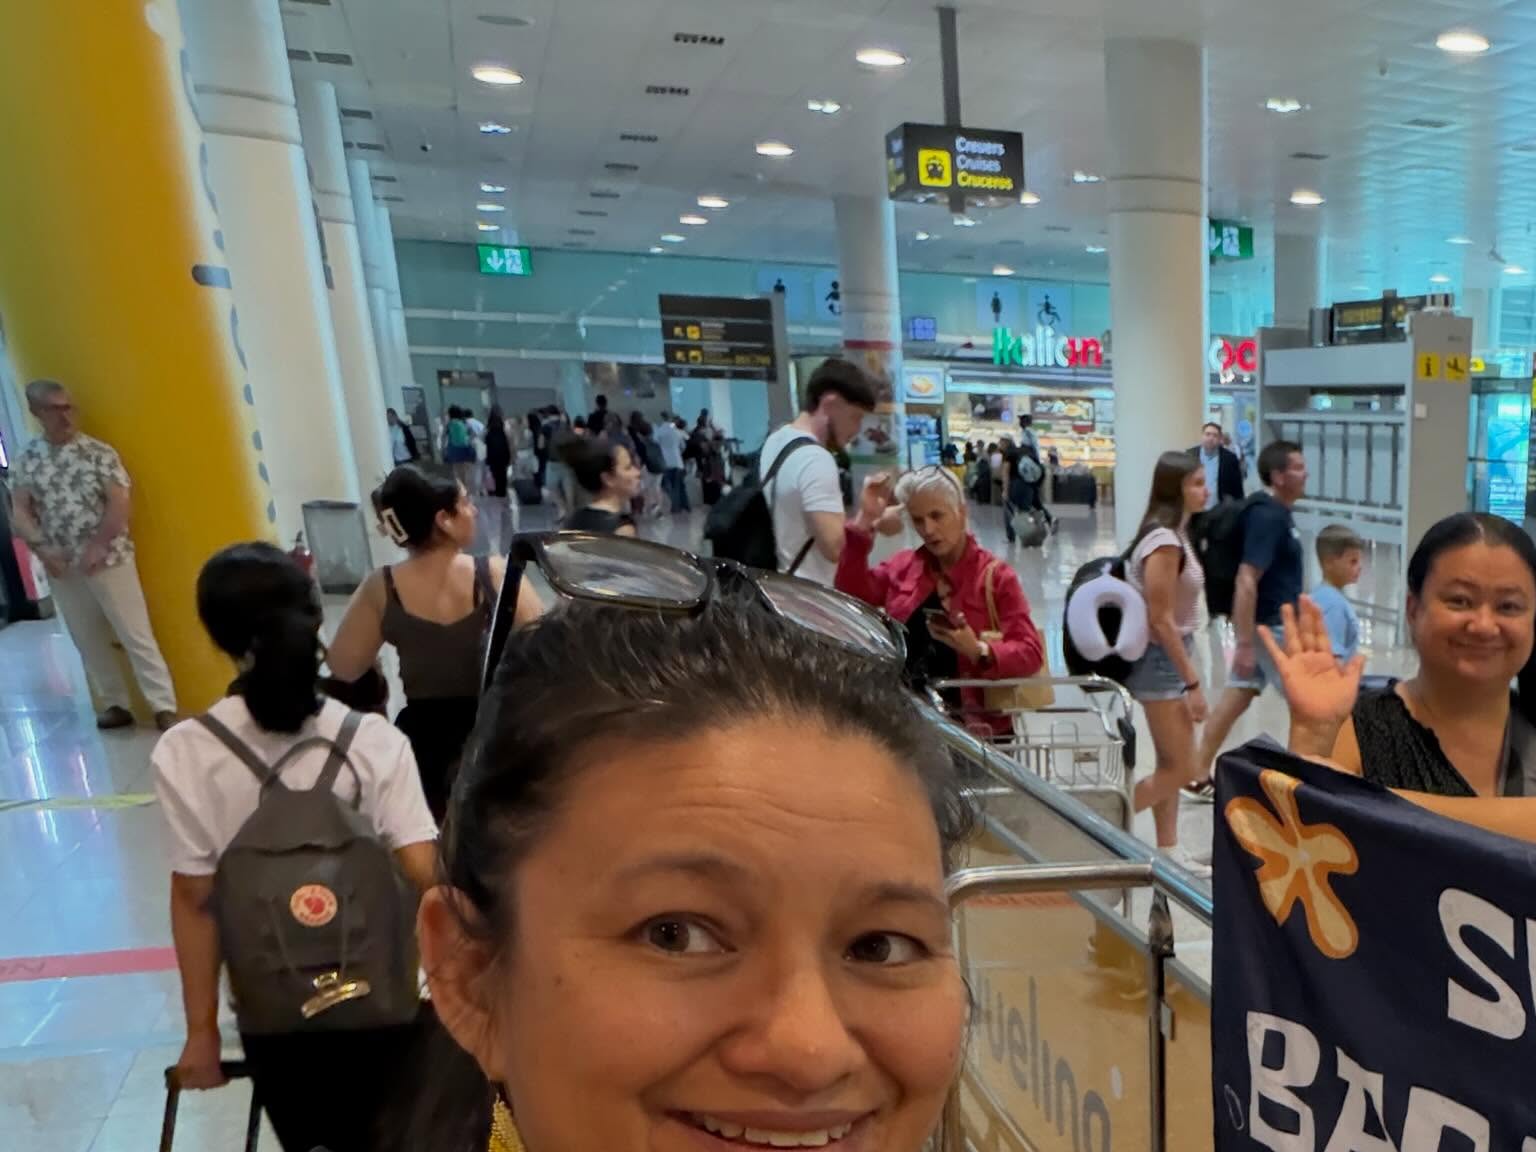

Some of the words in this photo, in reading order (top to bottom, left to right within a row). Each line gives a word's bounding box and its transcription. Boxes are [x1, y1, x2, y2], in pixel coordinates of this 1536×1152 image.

[956, 154, 1001, 172] Cruises
[957, 170, 1014, 191] Cruceros
[993, 325, 1104, 368] Italian
